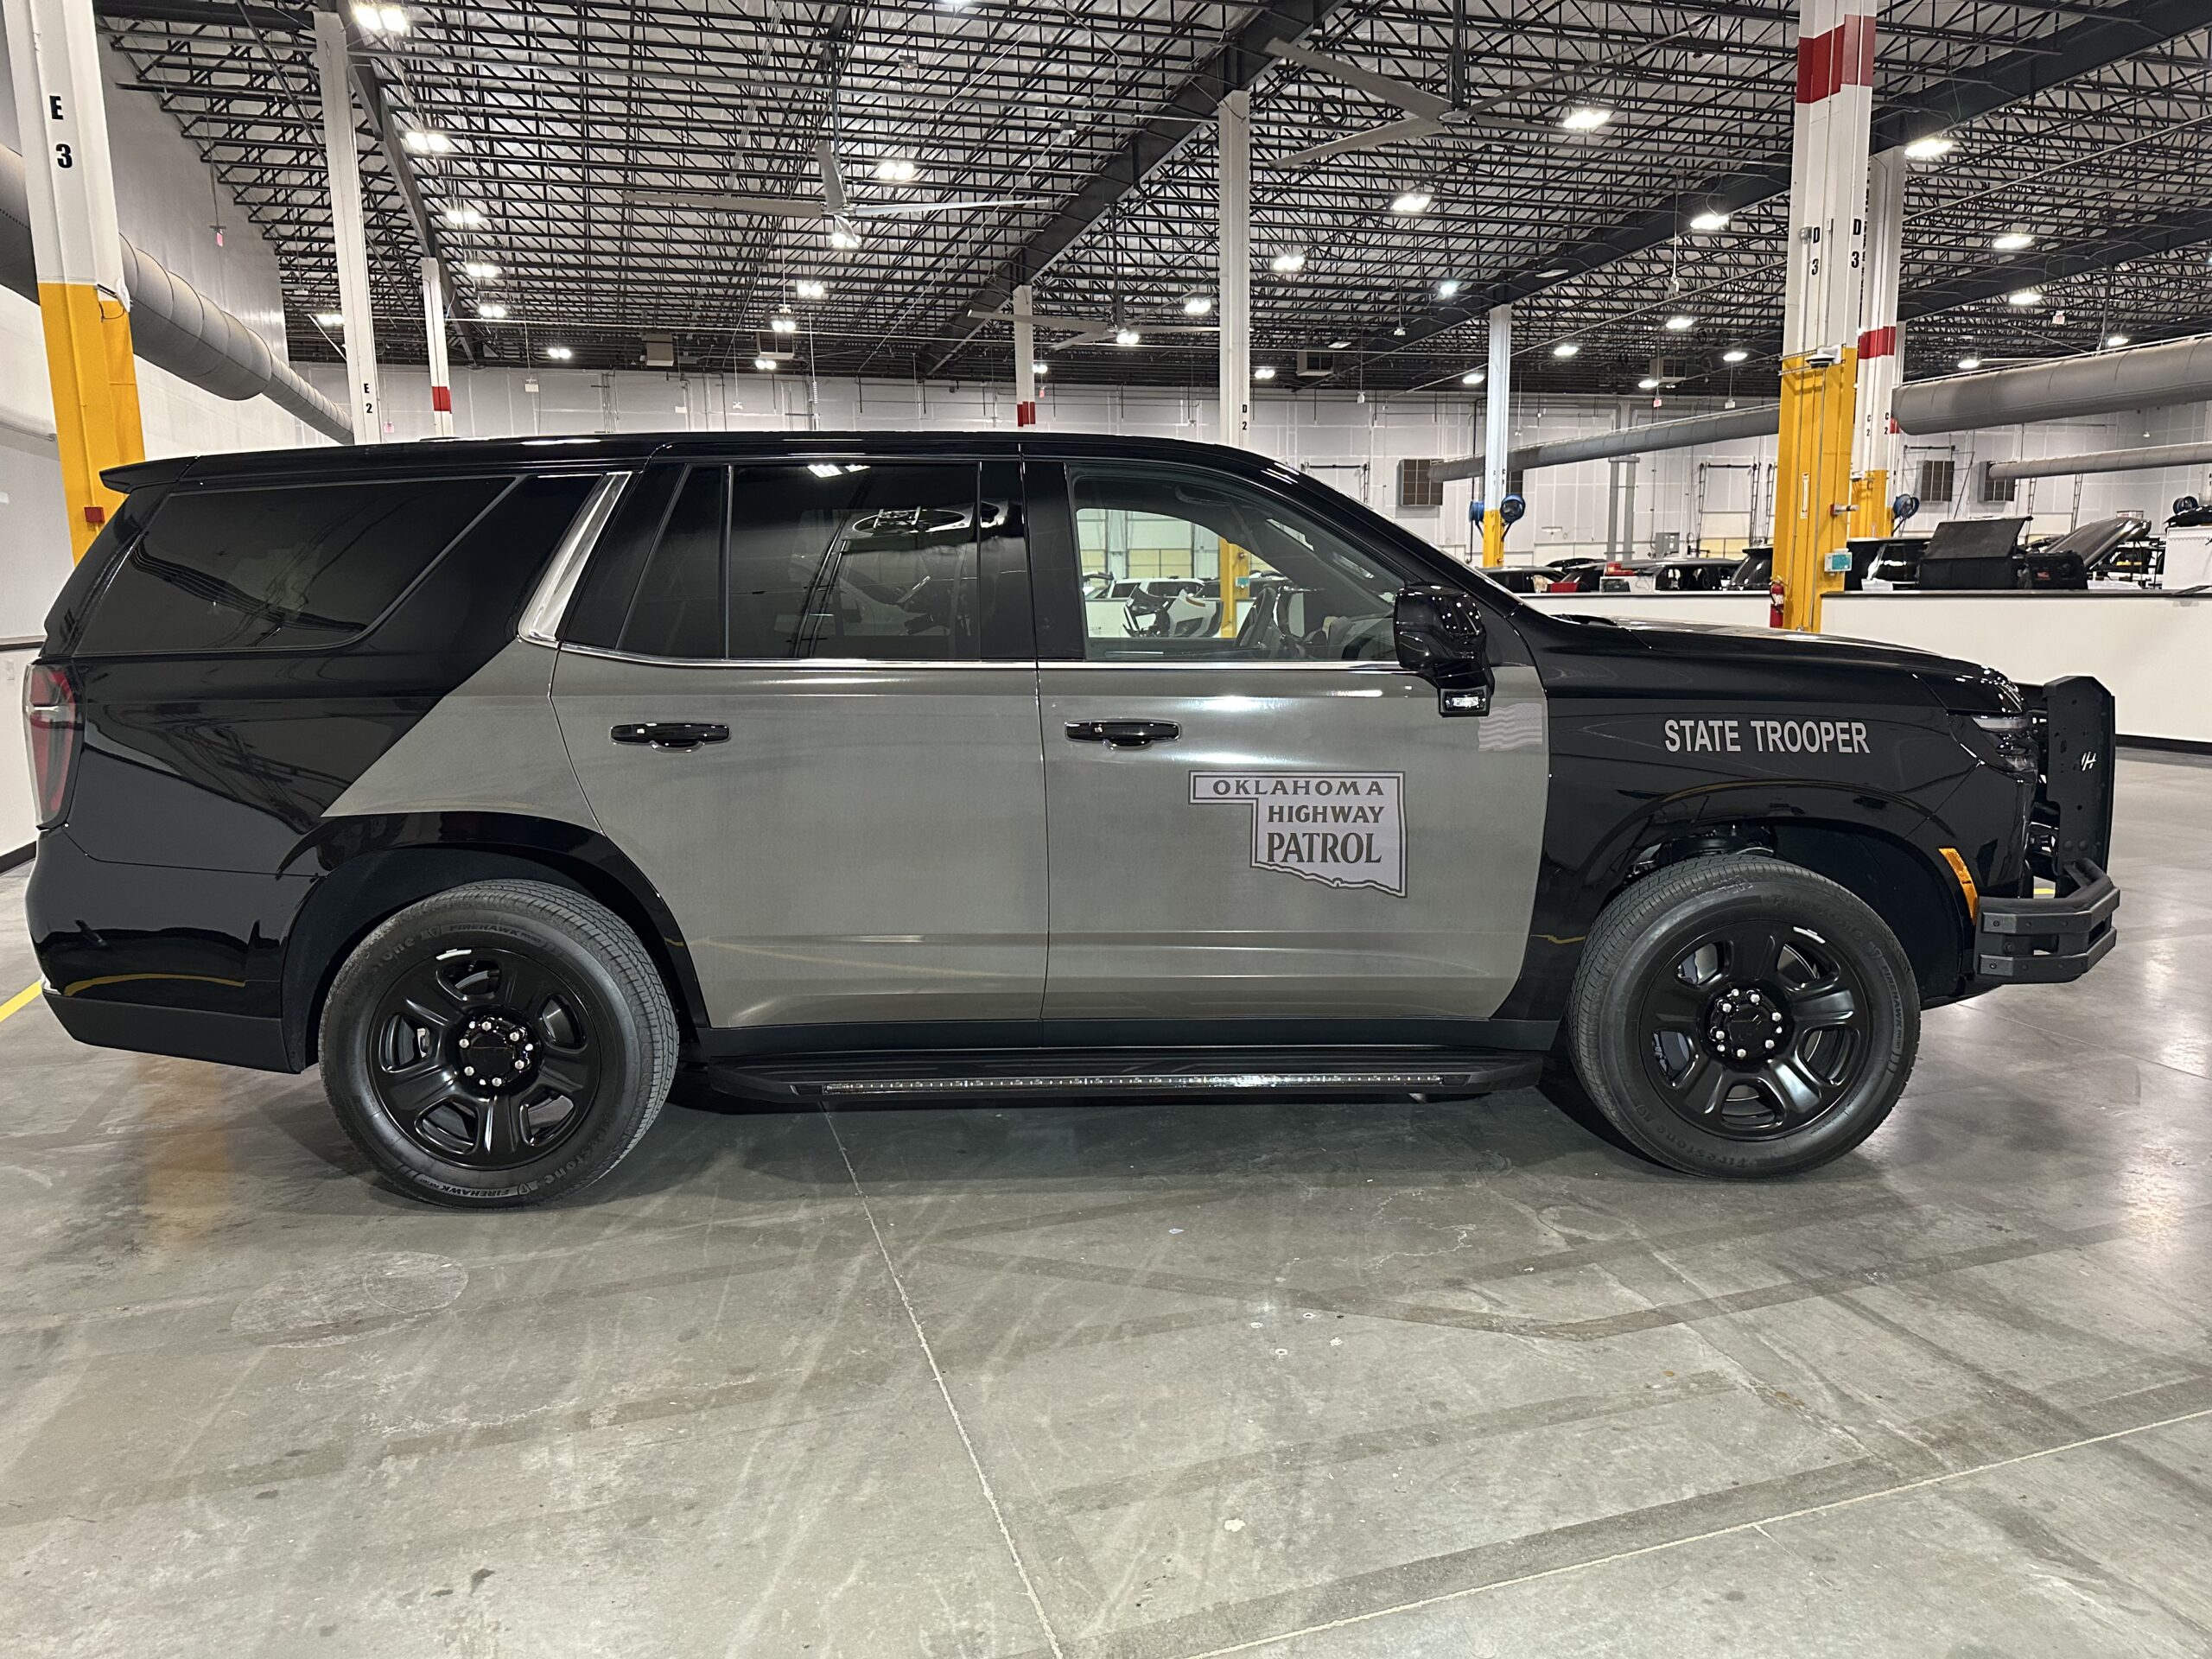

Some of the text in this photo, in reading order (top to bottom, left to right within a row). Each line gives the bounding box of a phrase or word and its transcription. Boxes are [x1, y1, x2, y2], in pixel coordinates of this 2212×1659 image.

[49, 95, 64, 121] E
[55, 143, 73, 168] 3
[1813, 226, 1821, 244] D
[1853, 218, 1862, 235] D
[1811, 258, 1820, 276] 3
[1851, 251, 1859, 269] 3
[363, 383, 370, 394] E
[365, 403, 373, 414] 2
[1242, 404, 1248, 413] D
[1885, 411, 1890, 421] C
[1242, 421, 1248, 430] 2
[1866, 428, 1871, 436] 2
[1884, 426, 1889, 435] 2
[1664, 719, 1871, 754] STATE TROOPER
[1212, 779, 1385, 797] OKLAHOMA
[1267, 804, 1385, 823] HIGHWAY
[1267, 831, 1382, 864] PATROL
[448, 923, 520, 937] FIREHAWK
[1881, 964, 1904, 1028] FIREHAWK
[442, 1183, 512, 1198] FIREHAWK
